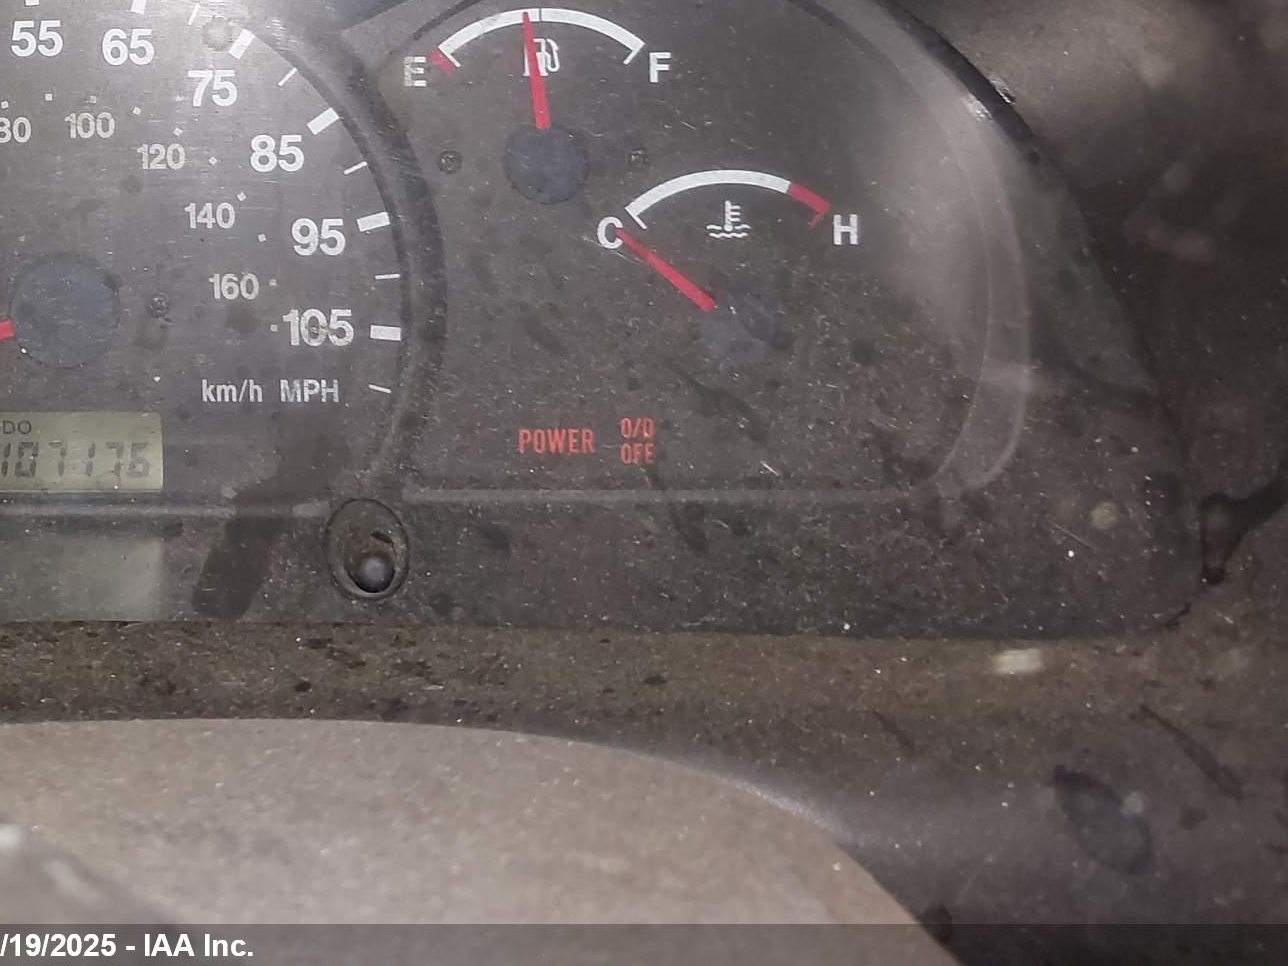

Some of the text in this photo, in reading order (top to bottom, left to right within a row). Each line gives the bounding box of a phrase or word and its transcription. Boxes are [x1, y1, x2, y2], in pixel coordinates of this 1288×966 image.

[11, 20, 63, 59] 55
[102, 28, 155, 66] 65
[404, 55, 427, 87] E
[648, 51, 672, 83] F
[187, 69, 238, 107] 75
[65, 113, 115, 140] 100
[137, 144, 185, 171] 120
[249, 134, 304, 173] 85
[184, 203, 236, 230] 140
[833, 214, 859, 245] H
[290, 217, 347, 256] 95
[596, 216, 623, 250] C
[208, 273, 260, 300] 160
[282, 308, 355, 346] 105
[200, 378, 340, 403] km/h MPH
[518, 428, 596, 455] POWER
[620, 442, 655, 465] OFF
